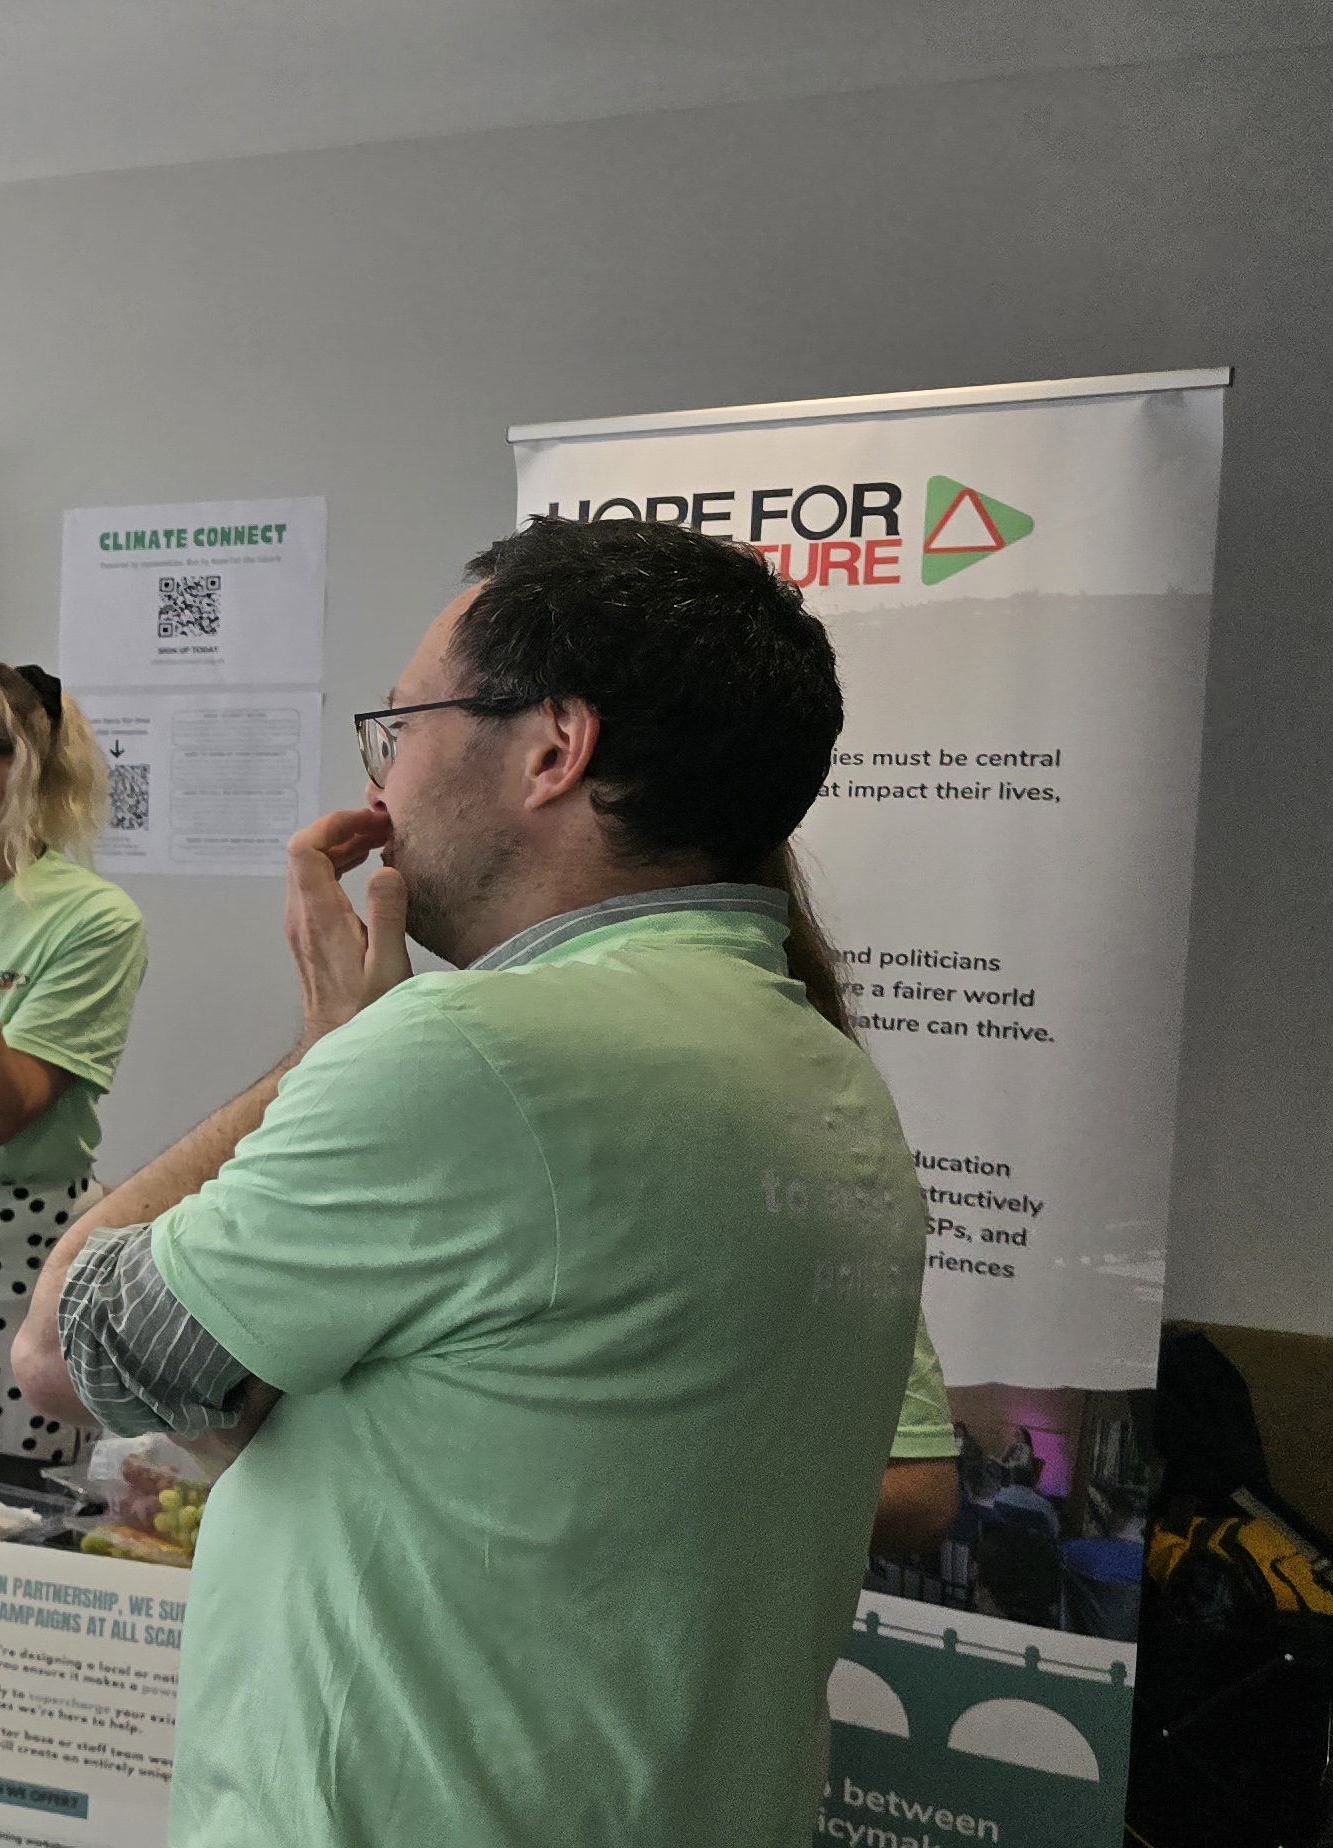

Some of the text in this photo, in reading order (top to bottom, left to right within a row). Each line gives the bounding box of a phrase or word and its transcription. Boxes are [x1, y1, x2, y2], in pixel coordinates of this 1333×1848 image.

[750, 482, 903, 541] FOR
[99, 523, 287, 551] CLIMATE CONNECT
[873, 750, 932, 766] must
[938, 748, 968, 767] be
[975, 748, 1062, 768] central
[849, 781, 928, 801] impact
[936, 782, 992, 800] their
[998, 782, 1061, 803] lives,
[842, 946, 1001, 972] nd politicians
[871, 984, 885, 998] a
[892, 980, 958, 1003] fairer
[963, 988, 1035, 1008] world
[926, 1018, 968, 1037] can
[976, 1021, 1055, 1043] thrive.
[925, 1216, 1027, 1247] SPs, and
[928, 1251, 1015, 1278] riences
[129, 1594, 155, 1618] WE
[86, 1615, 106, 1637] AT
[111, 1619, 139, 1643] ALL
[19, 1647, 82, 1670] designing
[98, 1661, 131, 1676] local
[153, 1673, 179, 1685] nati
[83, 1675, 125, 1689] makes
[843, 1776, 999, 1843] between
